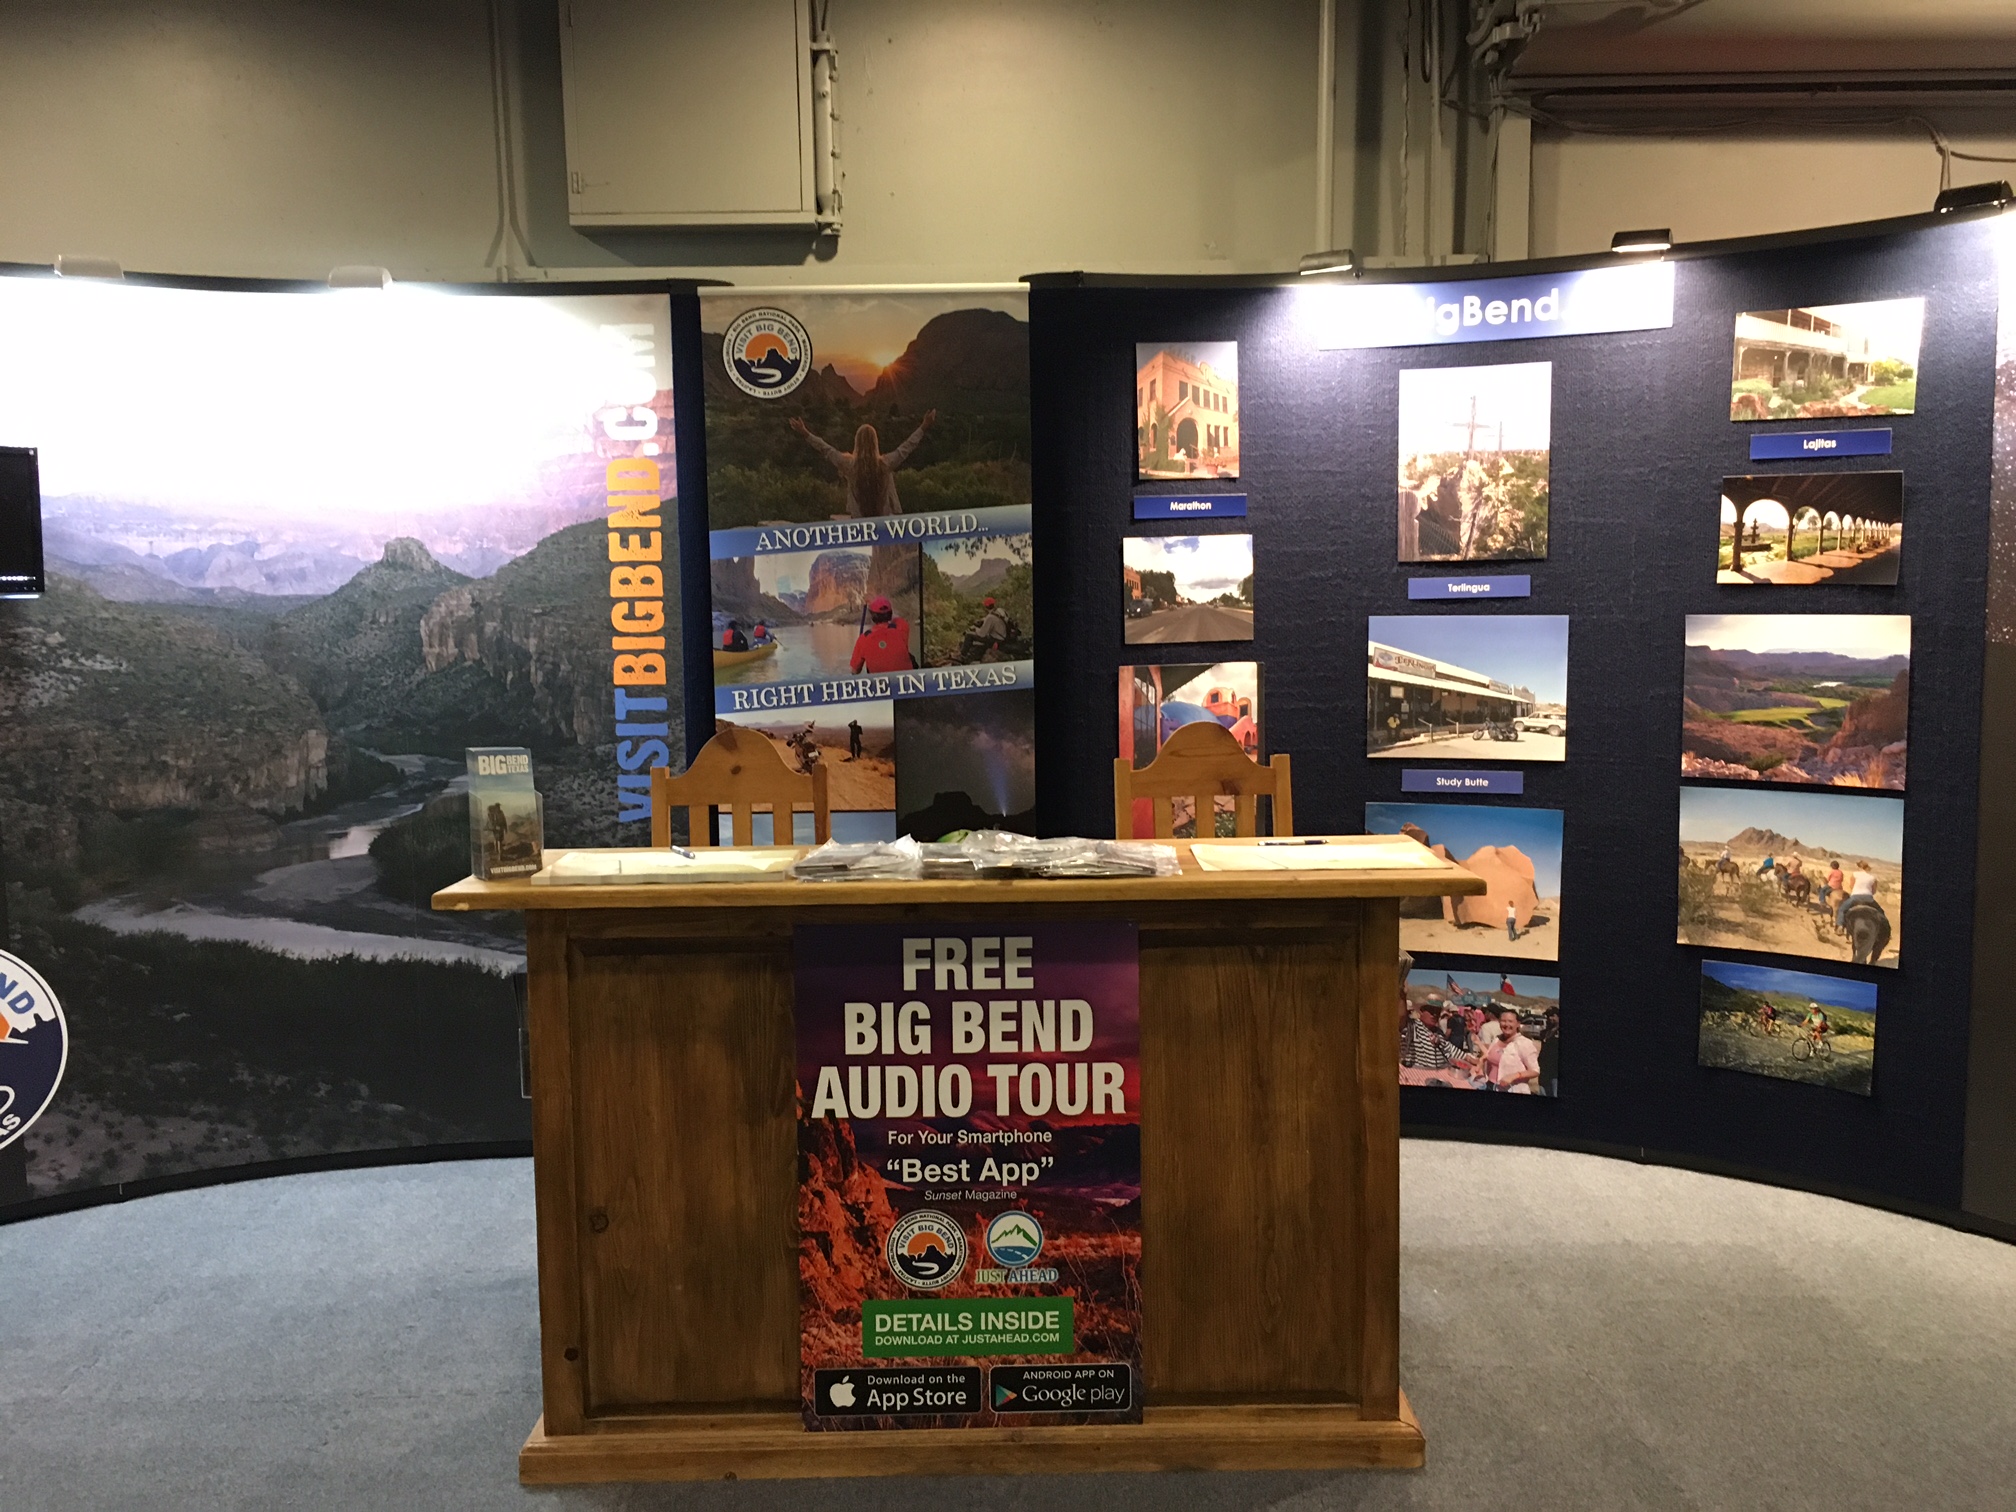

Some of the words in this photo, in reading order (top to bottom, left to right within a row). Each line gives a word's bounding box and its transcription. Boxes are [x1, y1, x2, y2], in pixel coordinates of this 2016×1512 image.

[736, 328, 754, 354] VISIT
[756, 323, 774, 332] BIG
[777, 326, 798, 354] BEND
[1803, 438, 1836, 451] Lajitas
[1170, 501, 1212, 511] Marathon
[756, 522, 878, 551] ANOTHER
[1448, 583, 1490, 593] Terlingua
[732, 684, 814, 710] RIGHT
[820, 676, 890, 702] HERE
[897, 674, 925, 695] IN
[933, 665, 1017, 691] TEXAS
[478, 755, 507, 775] BIG
[507, 755, 528, 764] BEND
[508, 765, 528, 773] TEXAS
[1436, 777, 1462, 787] Study
[1464, 778, 1489, 786] Butte
[903, 936, 1034, 991] FREE
[844, 1001, 932, 1055] BIG
[952, 999, 1094, 1054] BEND
[811, 1064, 973, 1119] AUDIO
[987, 1062, 1126, 1116] TOUR
[888, 1131, 914, 1145] For
[918, 1130, 953, 1145] Your
[957, 1130, 1052, 1146] Smartphone
[924, 1190, 962, 1201] Sunset
[965, 1190, 1017, 1202] Magazine
[920, 1214, 944, 1223] NATIONAL
[899, 1228, 915, 1249] VISIT
[936, 1228, 954, 1248] BEND
[975, 1269, 1007, 1284] JUST
[1007, 1268, 1059, 1283] AHEAD
[875, 1312, 973, 1332] DETAILS
[980, 1311, 1060, 1330] INSIDE
[875, 1334, 943, 1346] DOWNLOAD
[945, 1334, 960, 1344] AT
[962, 1332, 1060, 1345] JUSTAHEAD.COM
[867, 1374, 925, 1386] Download
[928, 1376, 943, 1384] on
[946, 1374, 966, 1384] the
[1023, 1370, 1071, 1380] ANDROID
[1075, 1370, 1096, 1379] APP
[1098, 1369, 1114, 1378] ON
[866, 1388, 909, 1411] App
[912, 1388, 967, 1407] Store
[1022, 1384, 1086, 1407] Google
[1090, 1384, 1125, 1404] play
